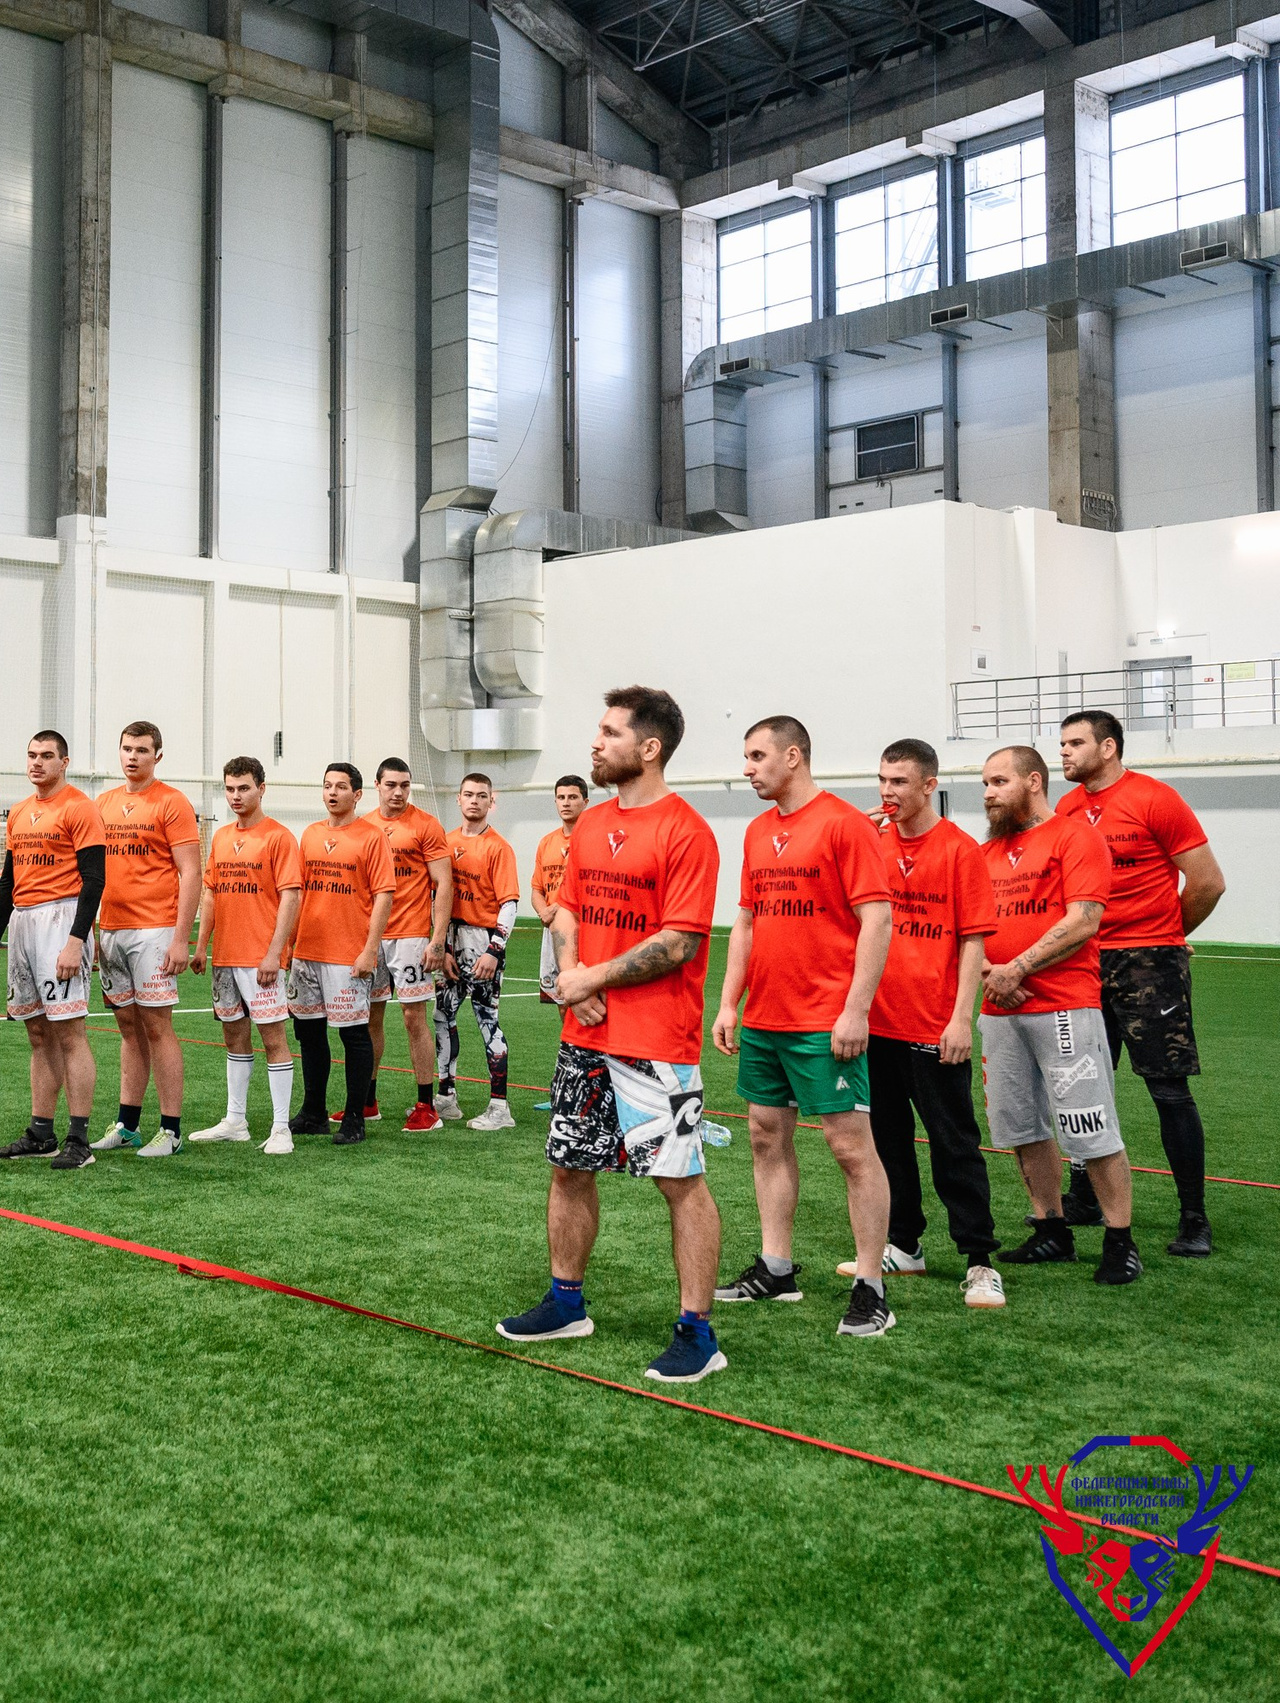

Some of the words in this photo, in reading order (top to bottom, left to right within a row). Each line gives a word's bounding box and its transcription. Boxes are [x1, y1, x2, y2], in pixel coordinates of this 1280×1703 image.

[404, 965, 426, 983] 31
[44, 978, 70, 1000] 27
[1057, 1010, 1073, 1054] ICONIC
[1058, 1110, 1105, 1135] PUNK
